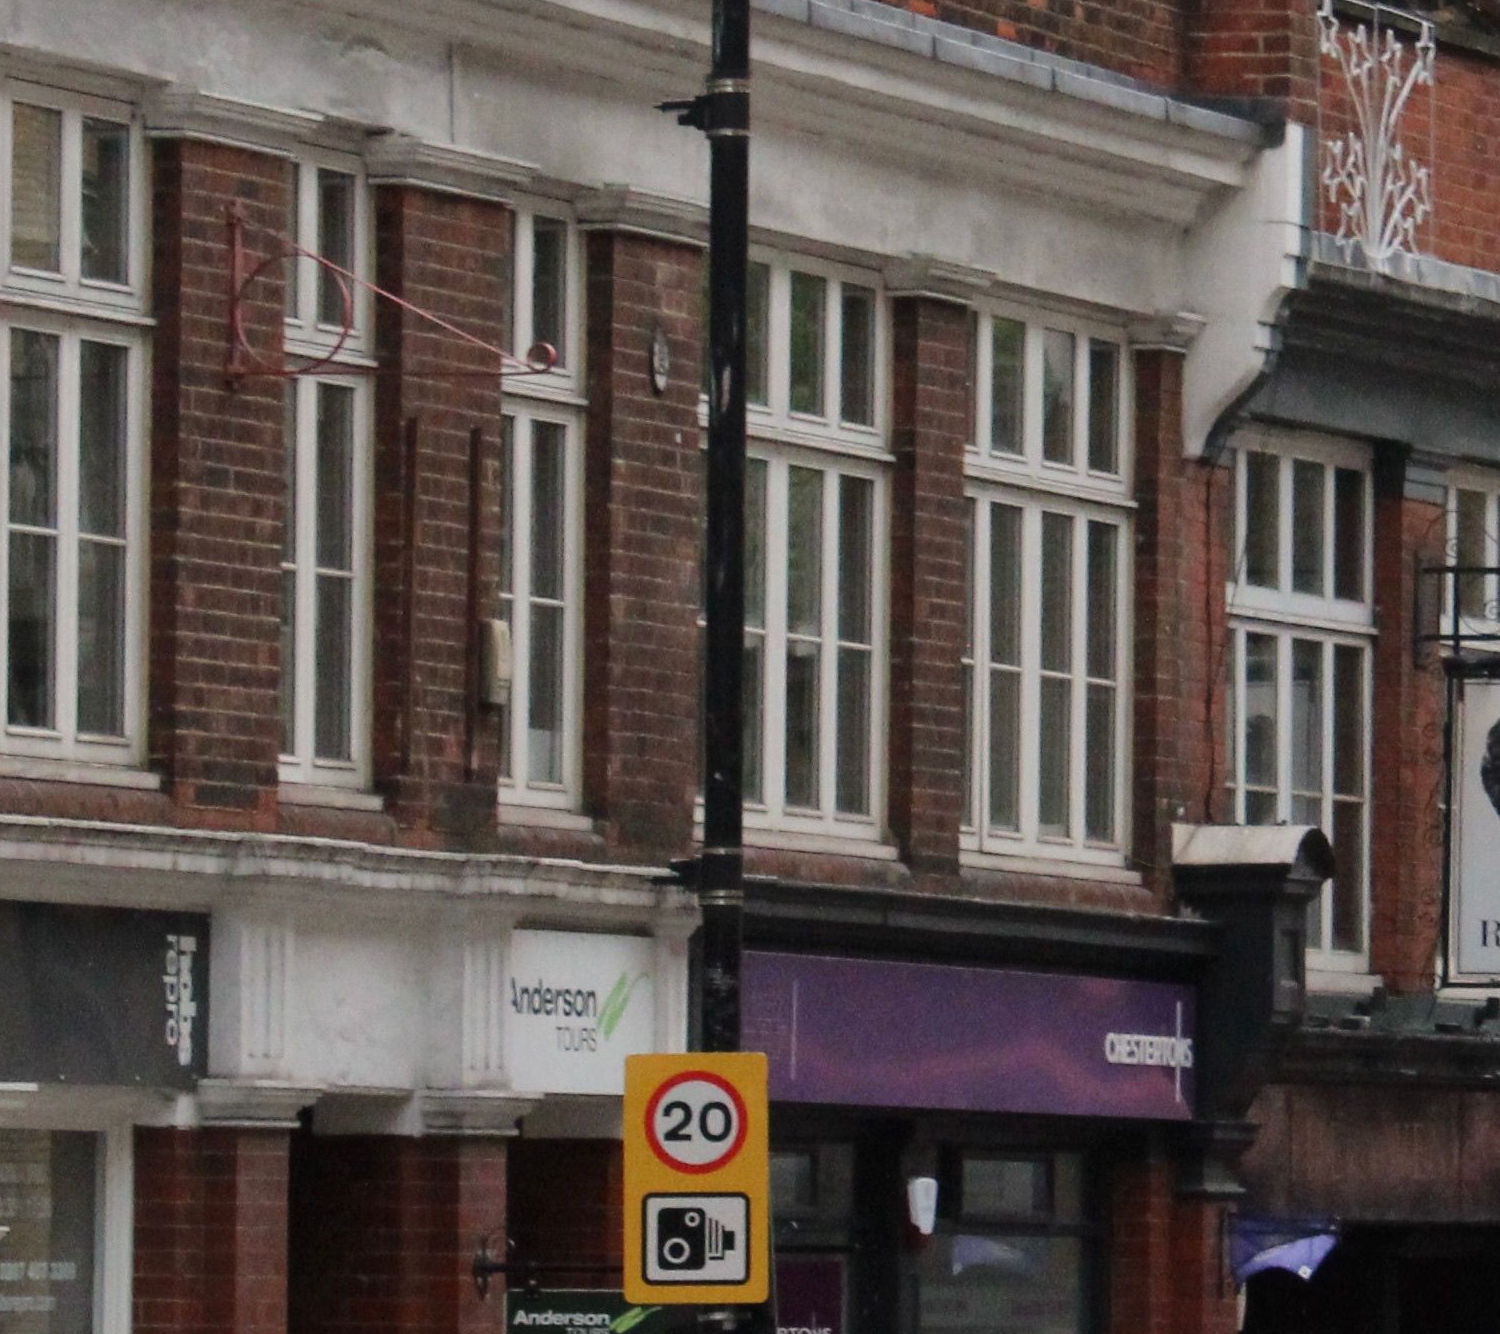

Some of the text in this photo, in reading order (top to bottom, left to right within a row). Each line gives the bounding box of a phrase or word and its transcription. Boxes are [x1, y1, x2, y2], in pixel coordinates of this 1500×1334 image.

[555, 1026, 597, 1052] TOURS
[1105, 1032, 1193, 1068] CHESTERTONS
[663, 1101, 732, 1142] 20
[513, 1310, 611, 1326] Anderson
